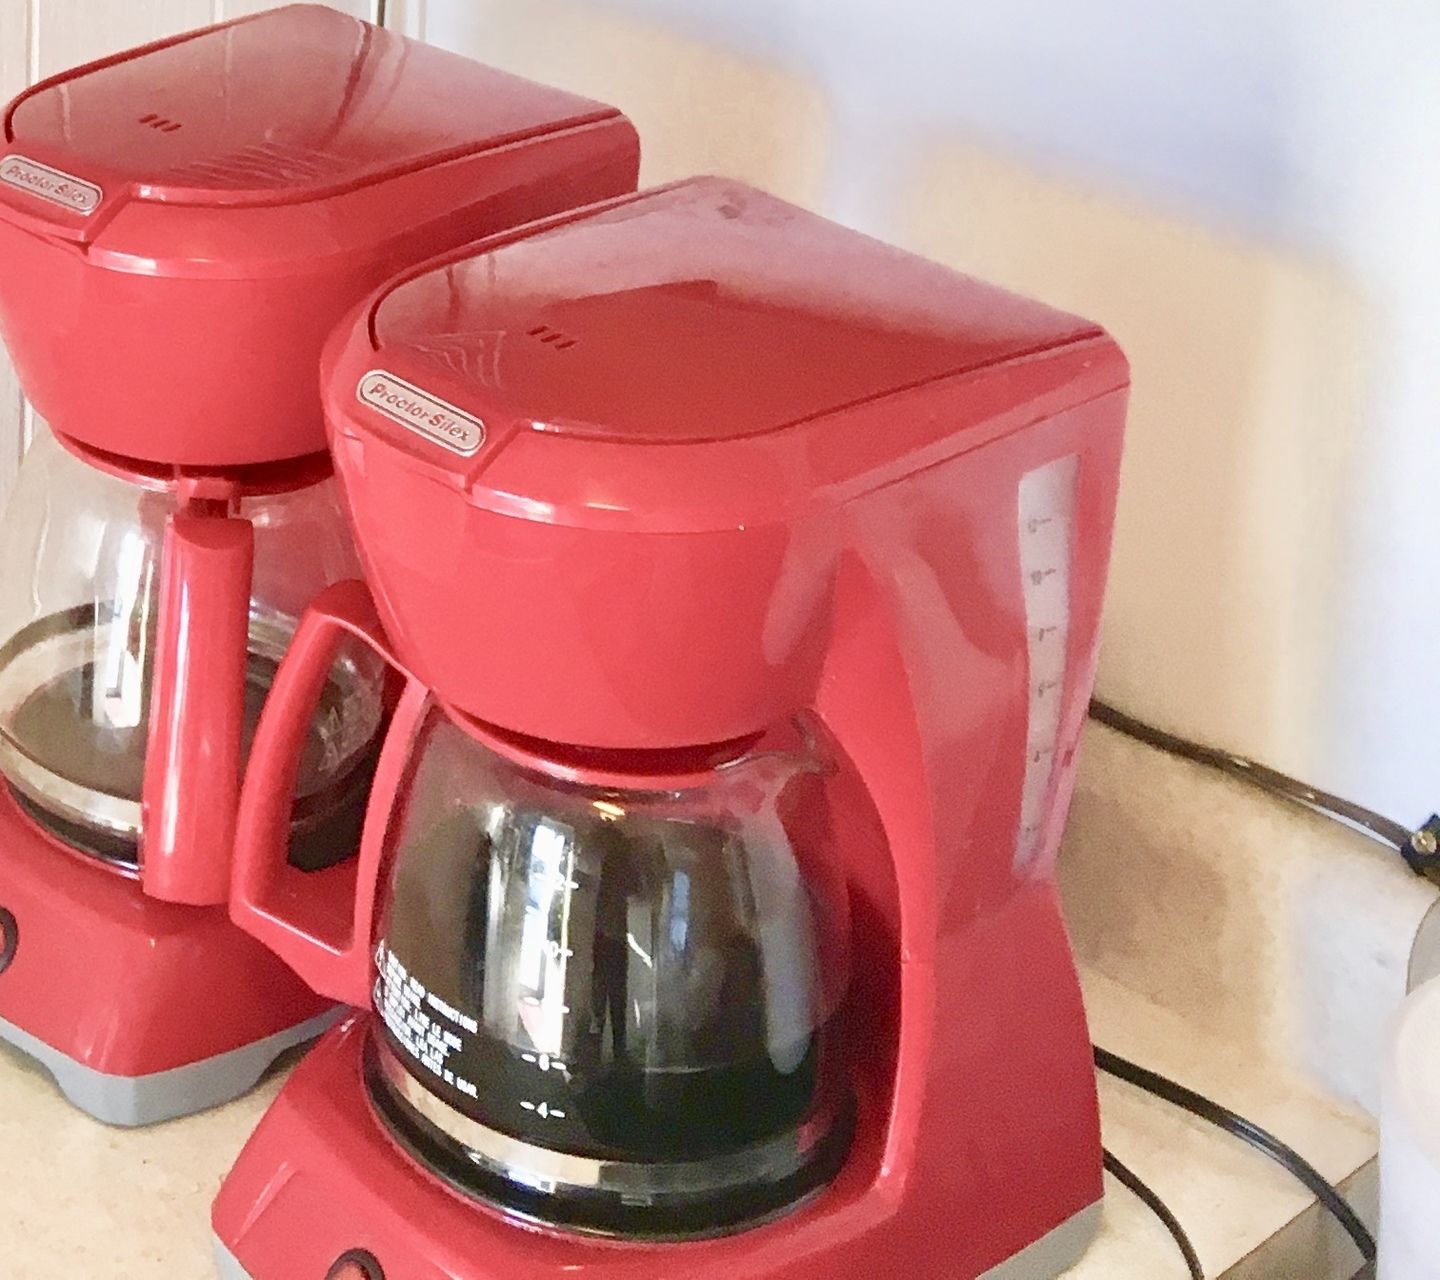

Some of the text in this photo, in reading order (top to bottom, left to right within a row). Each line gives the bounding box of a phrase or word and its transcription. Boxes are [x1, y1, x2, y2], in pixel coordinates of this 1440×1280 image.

[5, 163, 56, 193] Proctor
[368, 382, 472, 444] Proctor Silex
